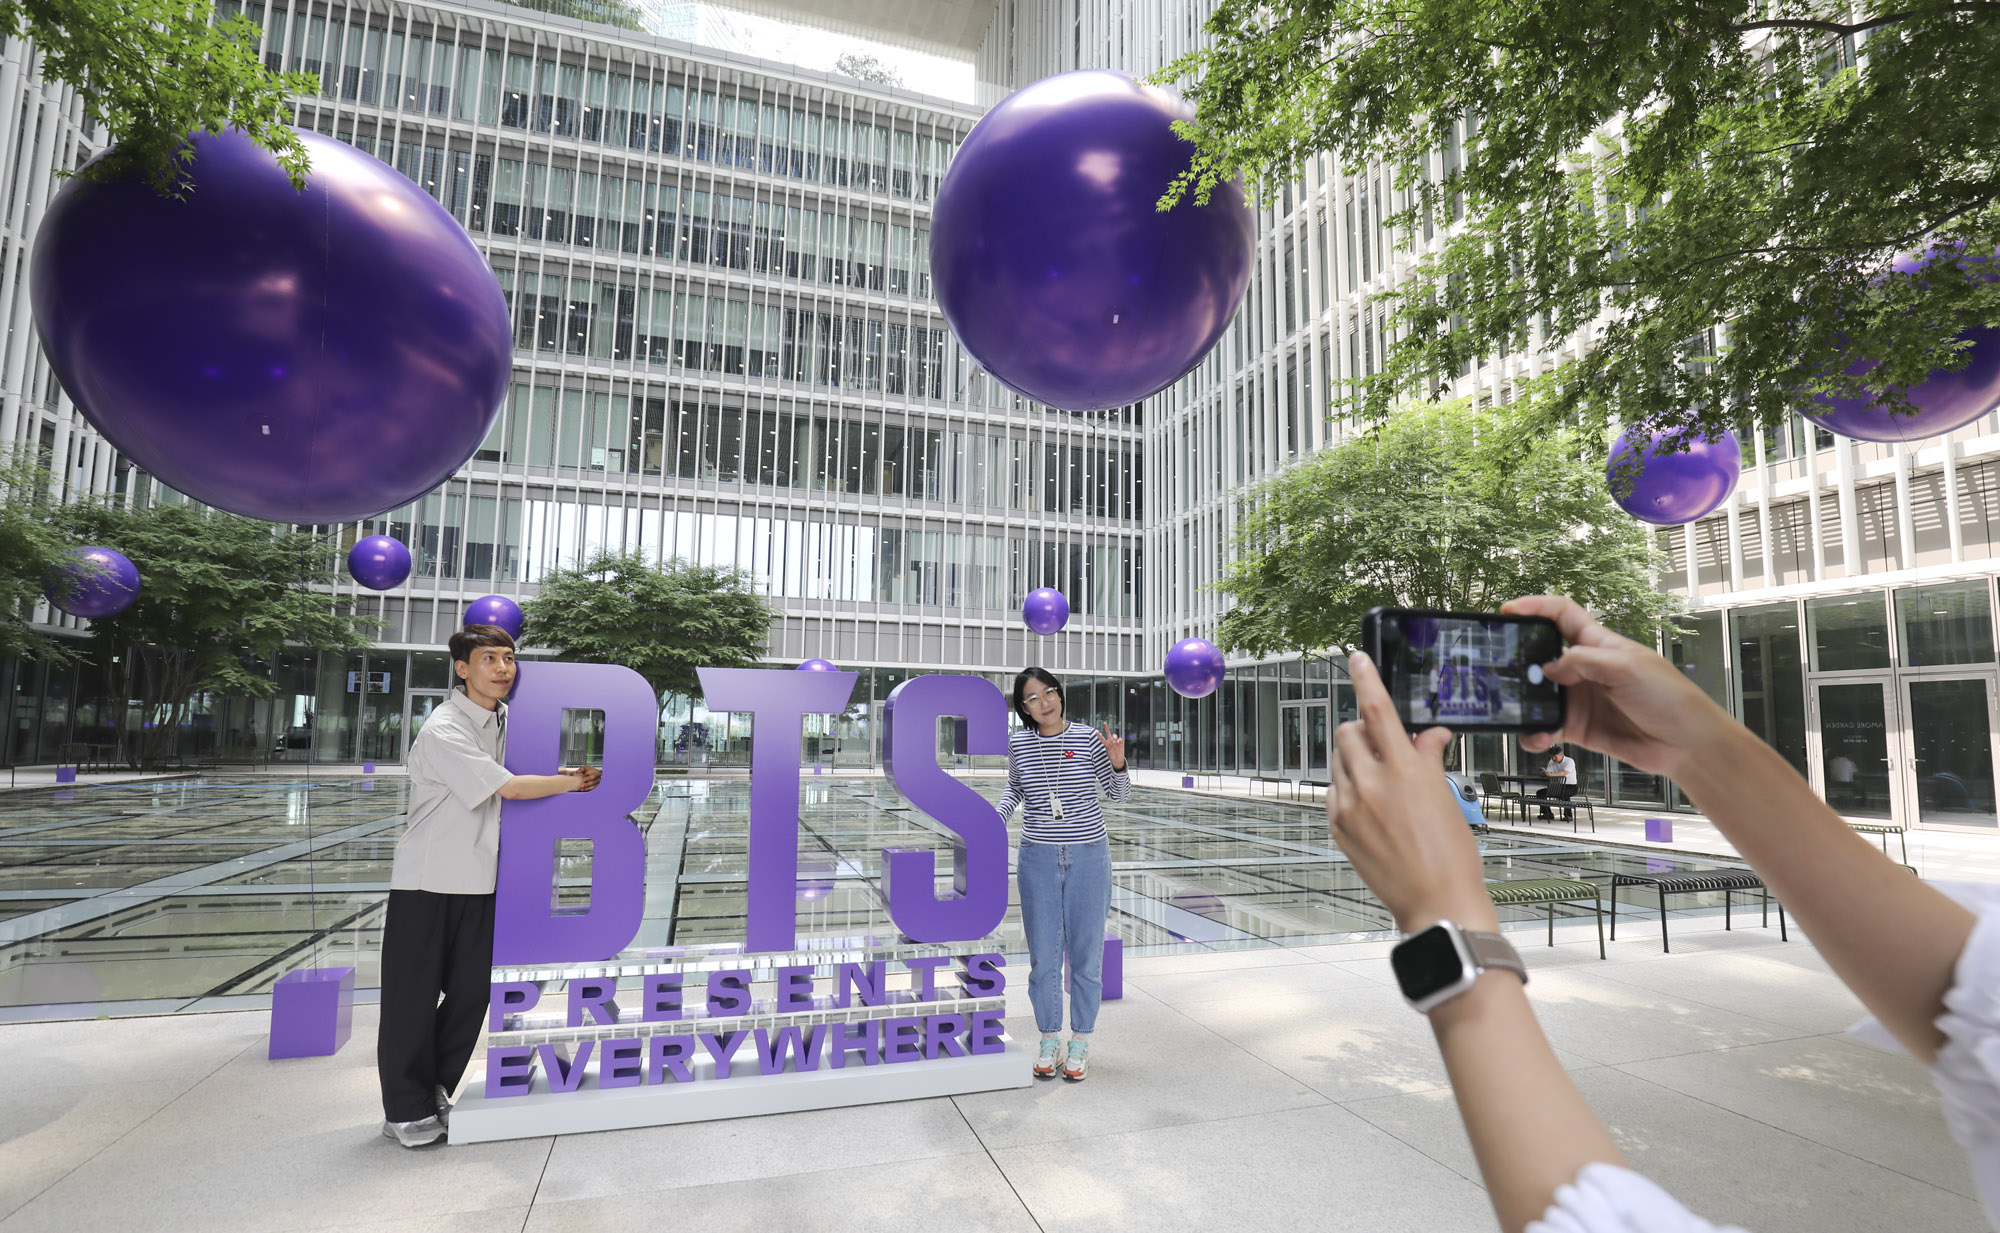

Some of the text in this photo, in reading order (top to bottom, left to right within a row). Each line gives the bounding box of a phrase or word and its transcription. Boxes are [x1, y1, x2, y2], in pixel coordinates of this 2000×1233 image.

[492, 661, 1009, 966] BTS
[489, 953, 1006, 1033] PRESENTS
[485, 1009, 1006, 1099] EVERYWHERE
